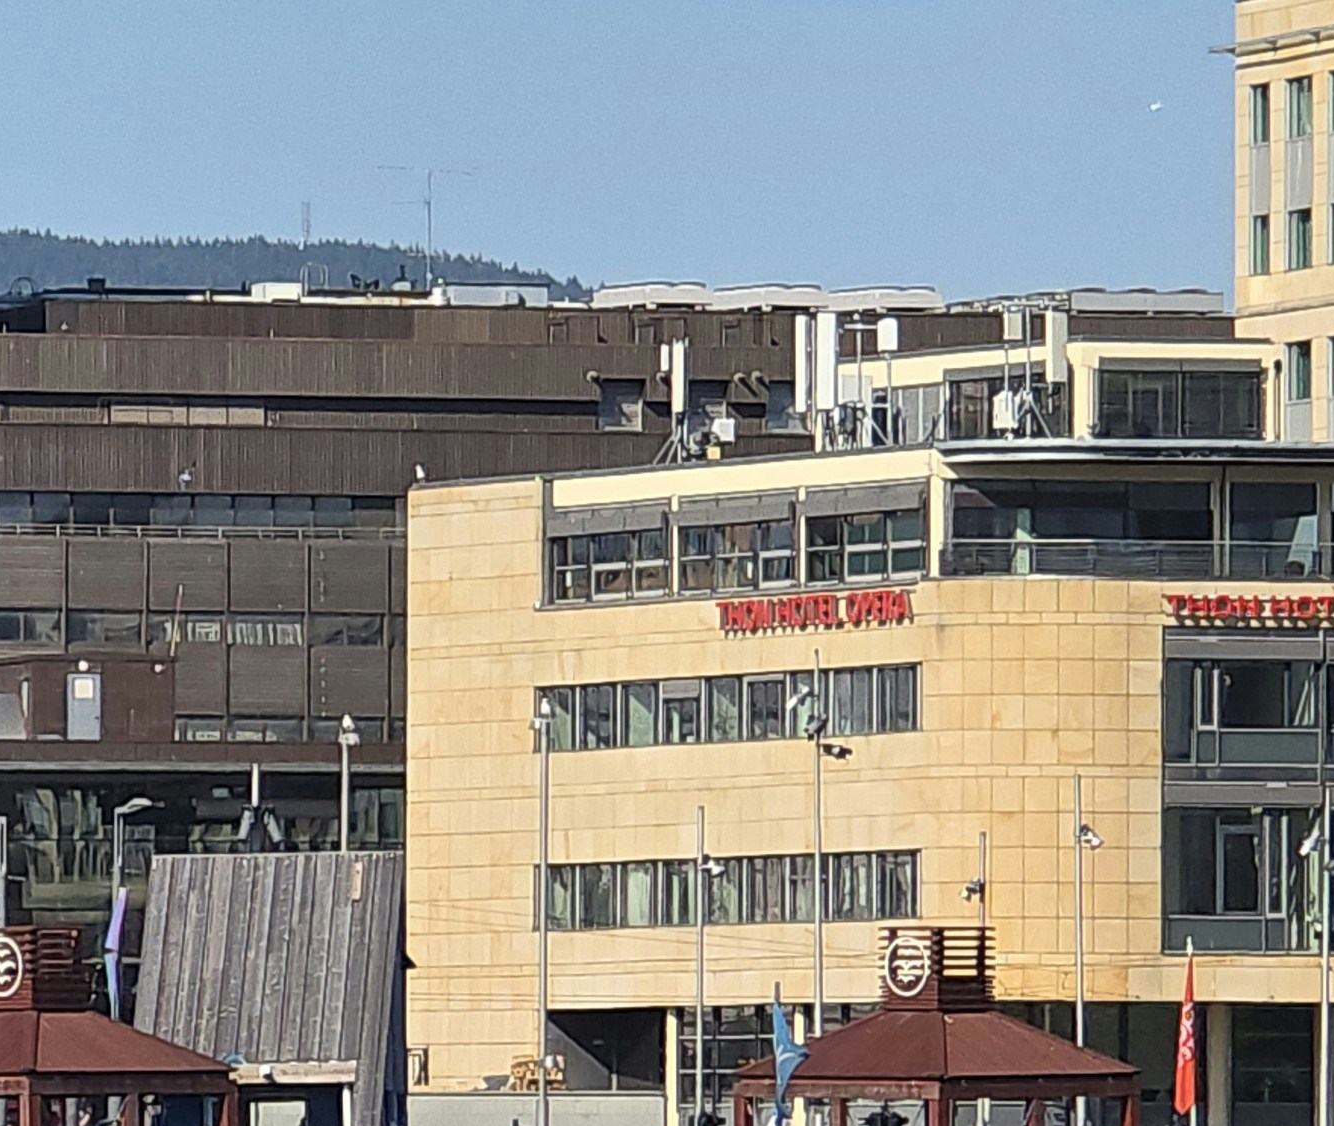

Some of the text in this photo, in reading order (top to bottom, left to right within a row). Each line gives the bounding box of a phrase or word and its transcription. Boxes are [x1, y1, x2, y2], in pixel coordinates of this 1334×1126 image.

[776, 593, 838, 627] HOTEL
[846, 589, 911, 623] OPERA
[1164, 594, 1260, 617] THON
